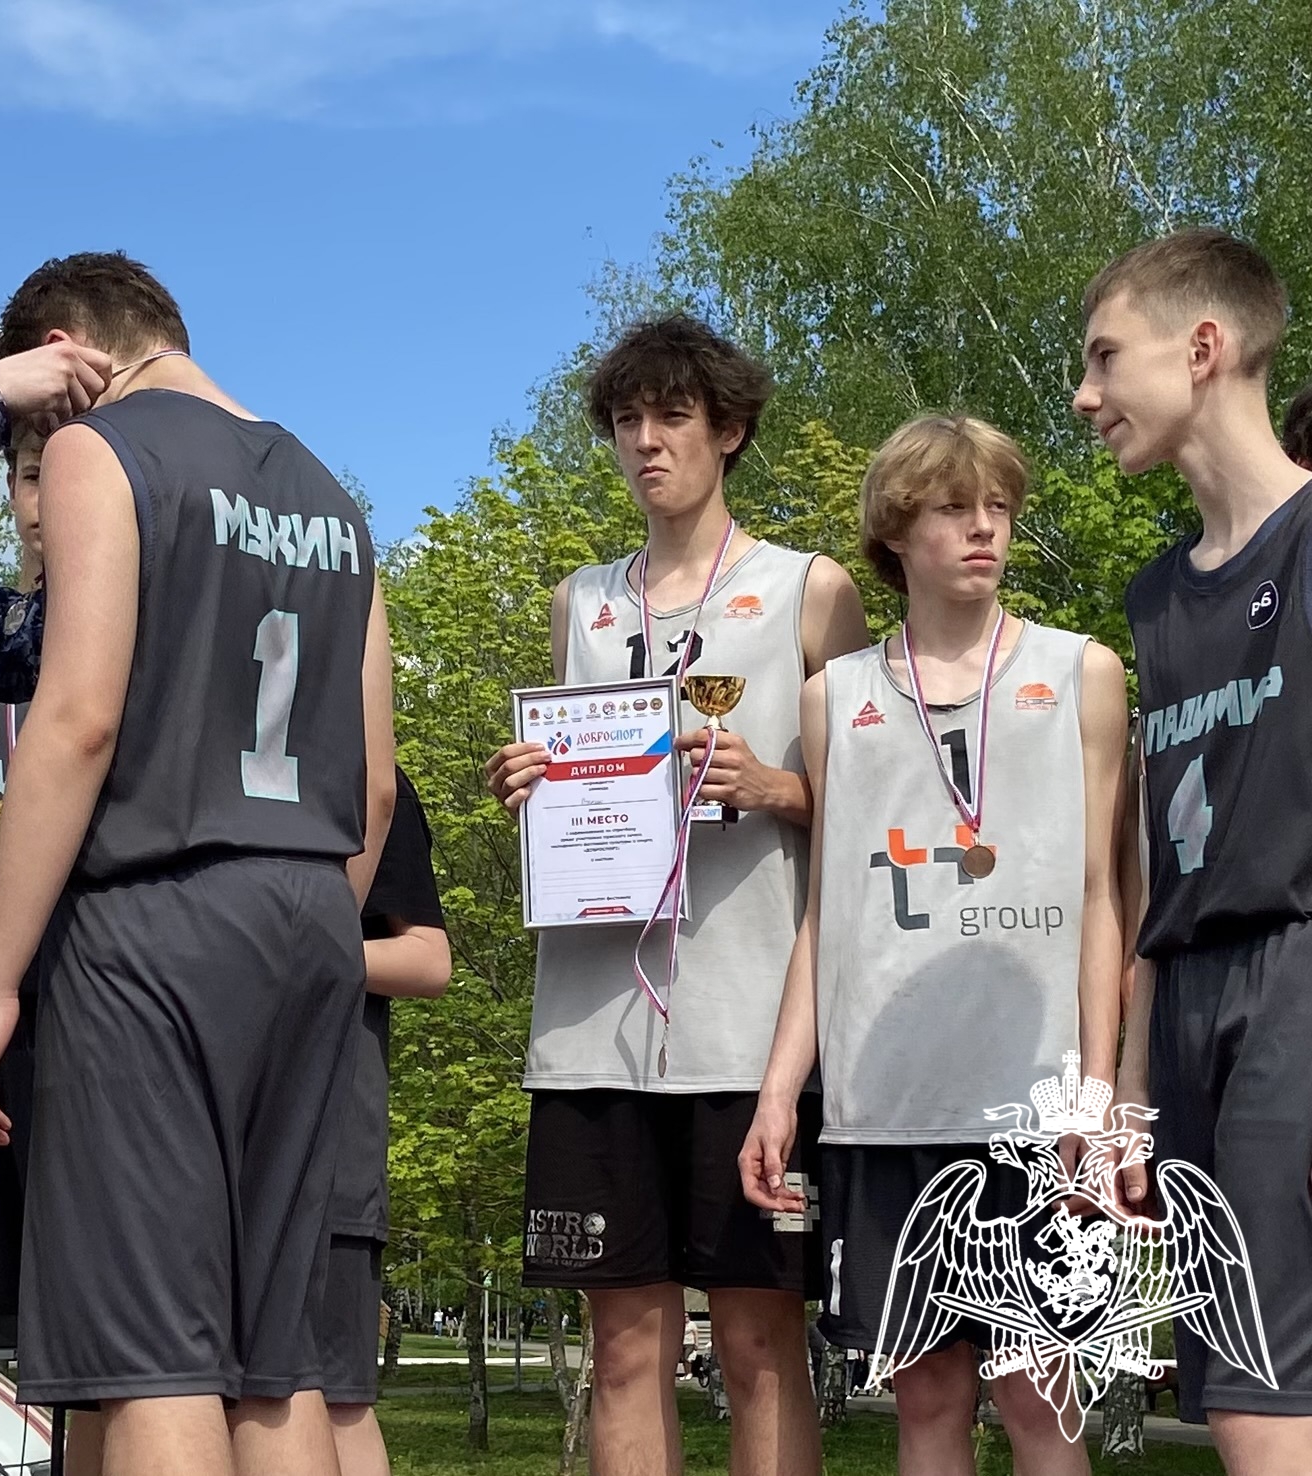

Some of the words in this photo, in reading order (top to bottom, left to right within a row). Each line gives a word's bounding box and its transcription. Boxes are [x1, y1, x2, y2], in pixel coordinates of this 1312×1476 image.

[210, 488, 360, 575] МУХИН
[626, 629, 704, 680] 12
[241, 608, 300, 803] 1
[852, 713, 886, 729] PEAK
[1142, 666, 1284, 757] ЛАДИМИР
[576, 728, 644, 746] ДОБРОСПОРТ
[570, 763, 626, 777] ДИПЛОМ
[940, 728, 971, 805] 1
[571, 817, 583, 827] III
[587, 813, 630, 826] МЕСТО
[959, 904, 1064, 937] group
